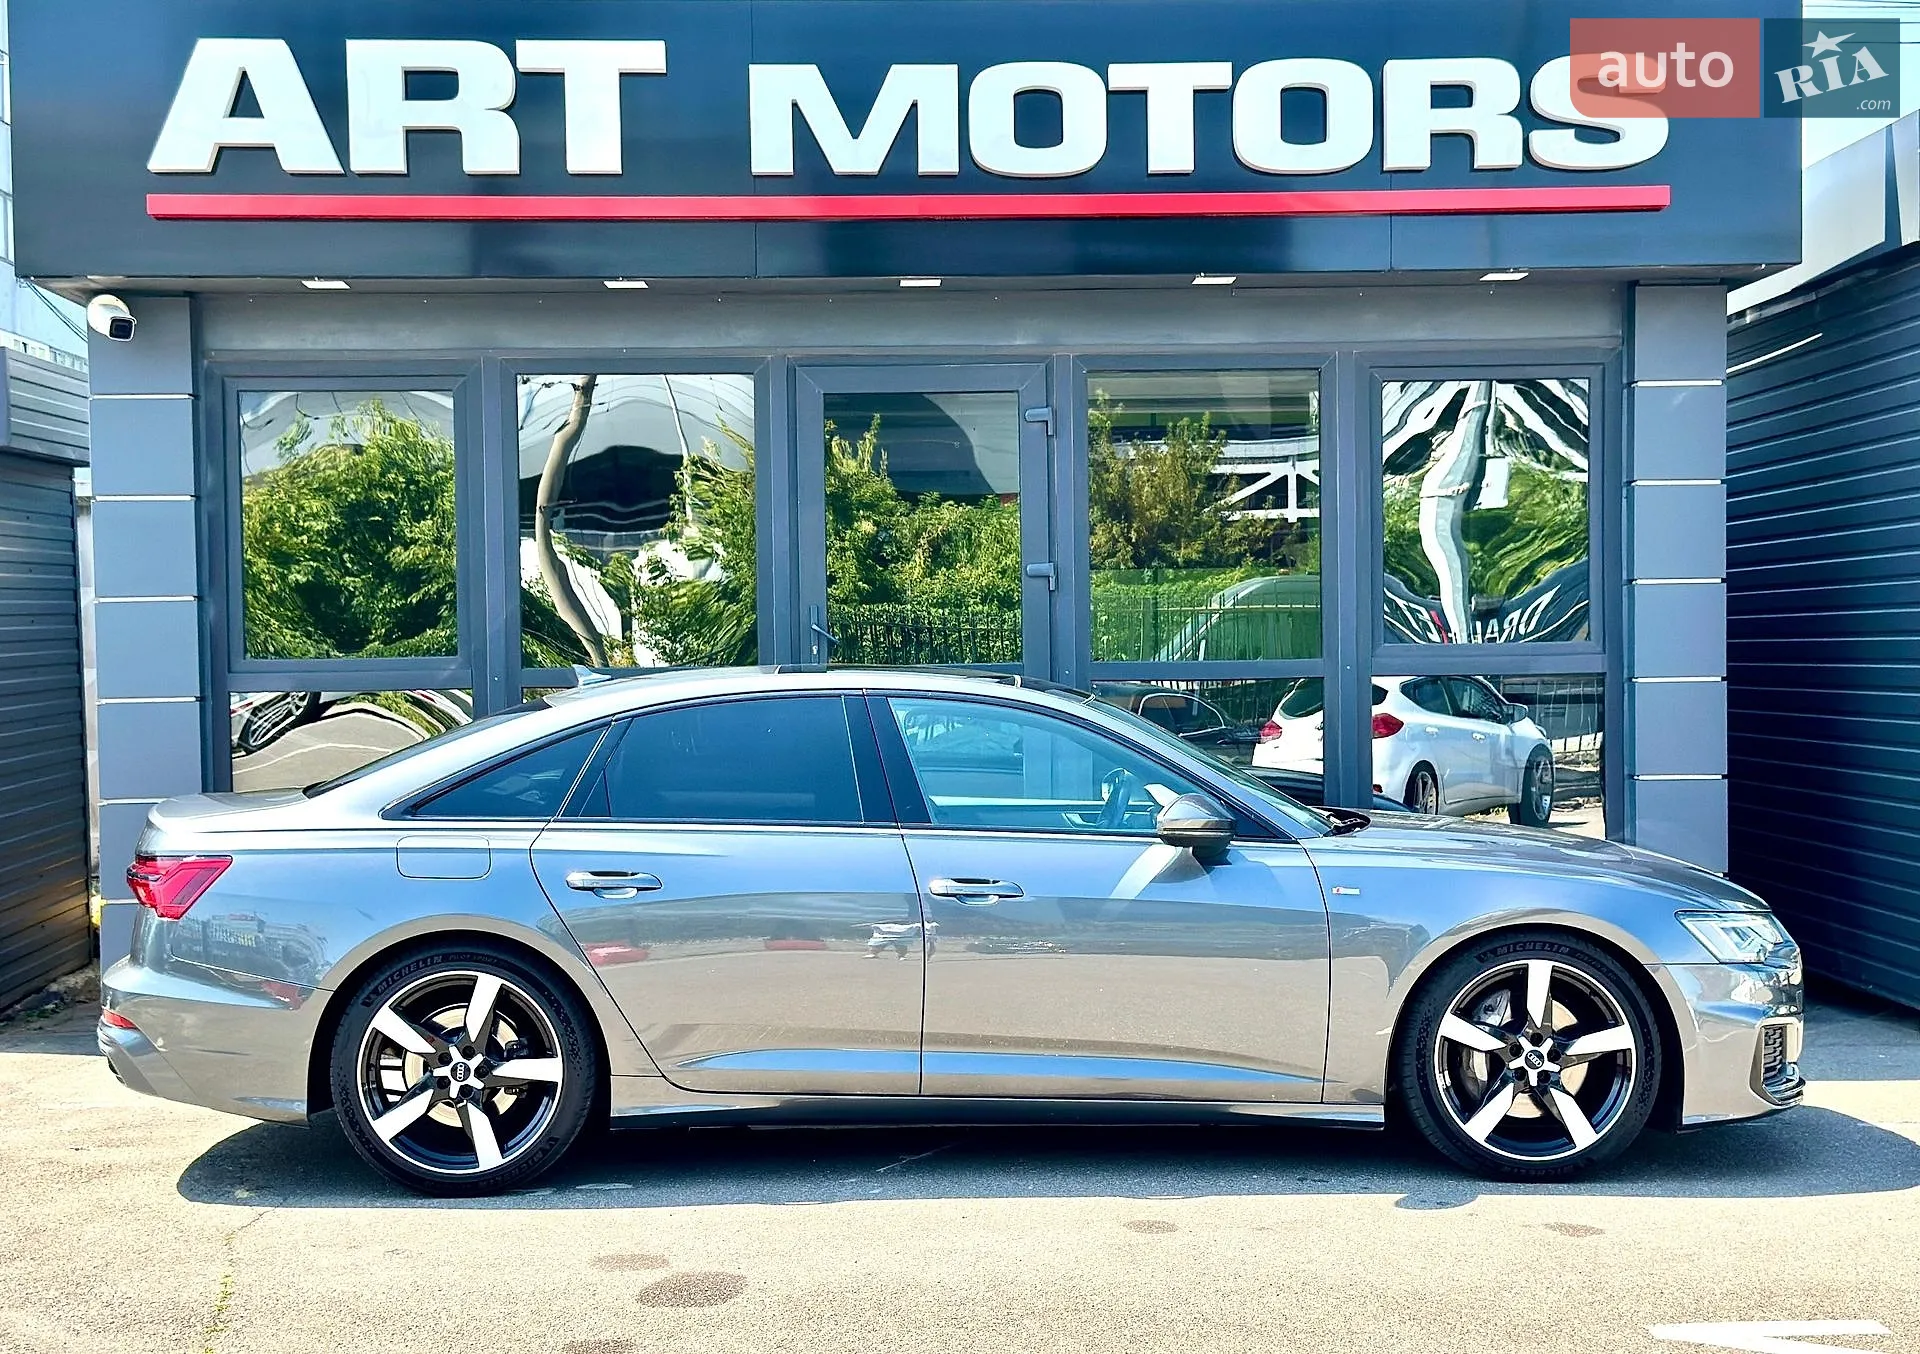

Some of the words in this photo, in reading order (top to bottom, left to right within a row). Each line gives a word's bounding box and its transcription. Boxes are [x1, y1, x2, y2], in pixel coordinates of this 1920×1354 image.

[147, 38, 667, 175] ART
[749, 56, 1670, 177] MOTORS
[1496, 941, 1570, 956] MICHELIN
[377, 955, 443, 994] MICHELIN
